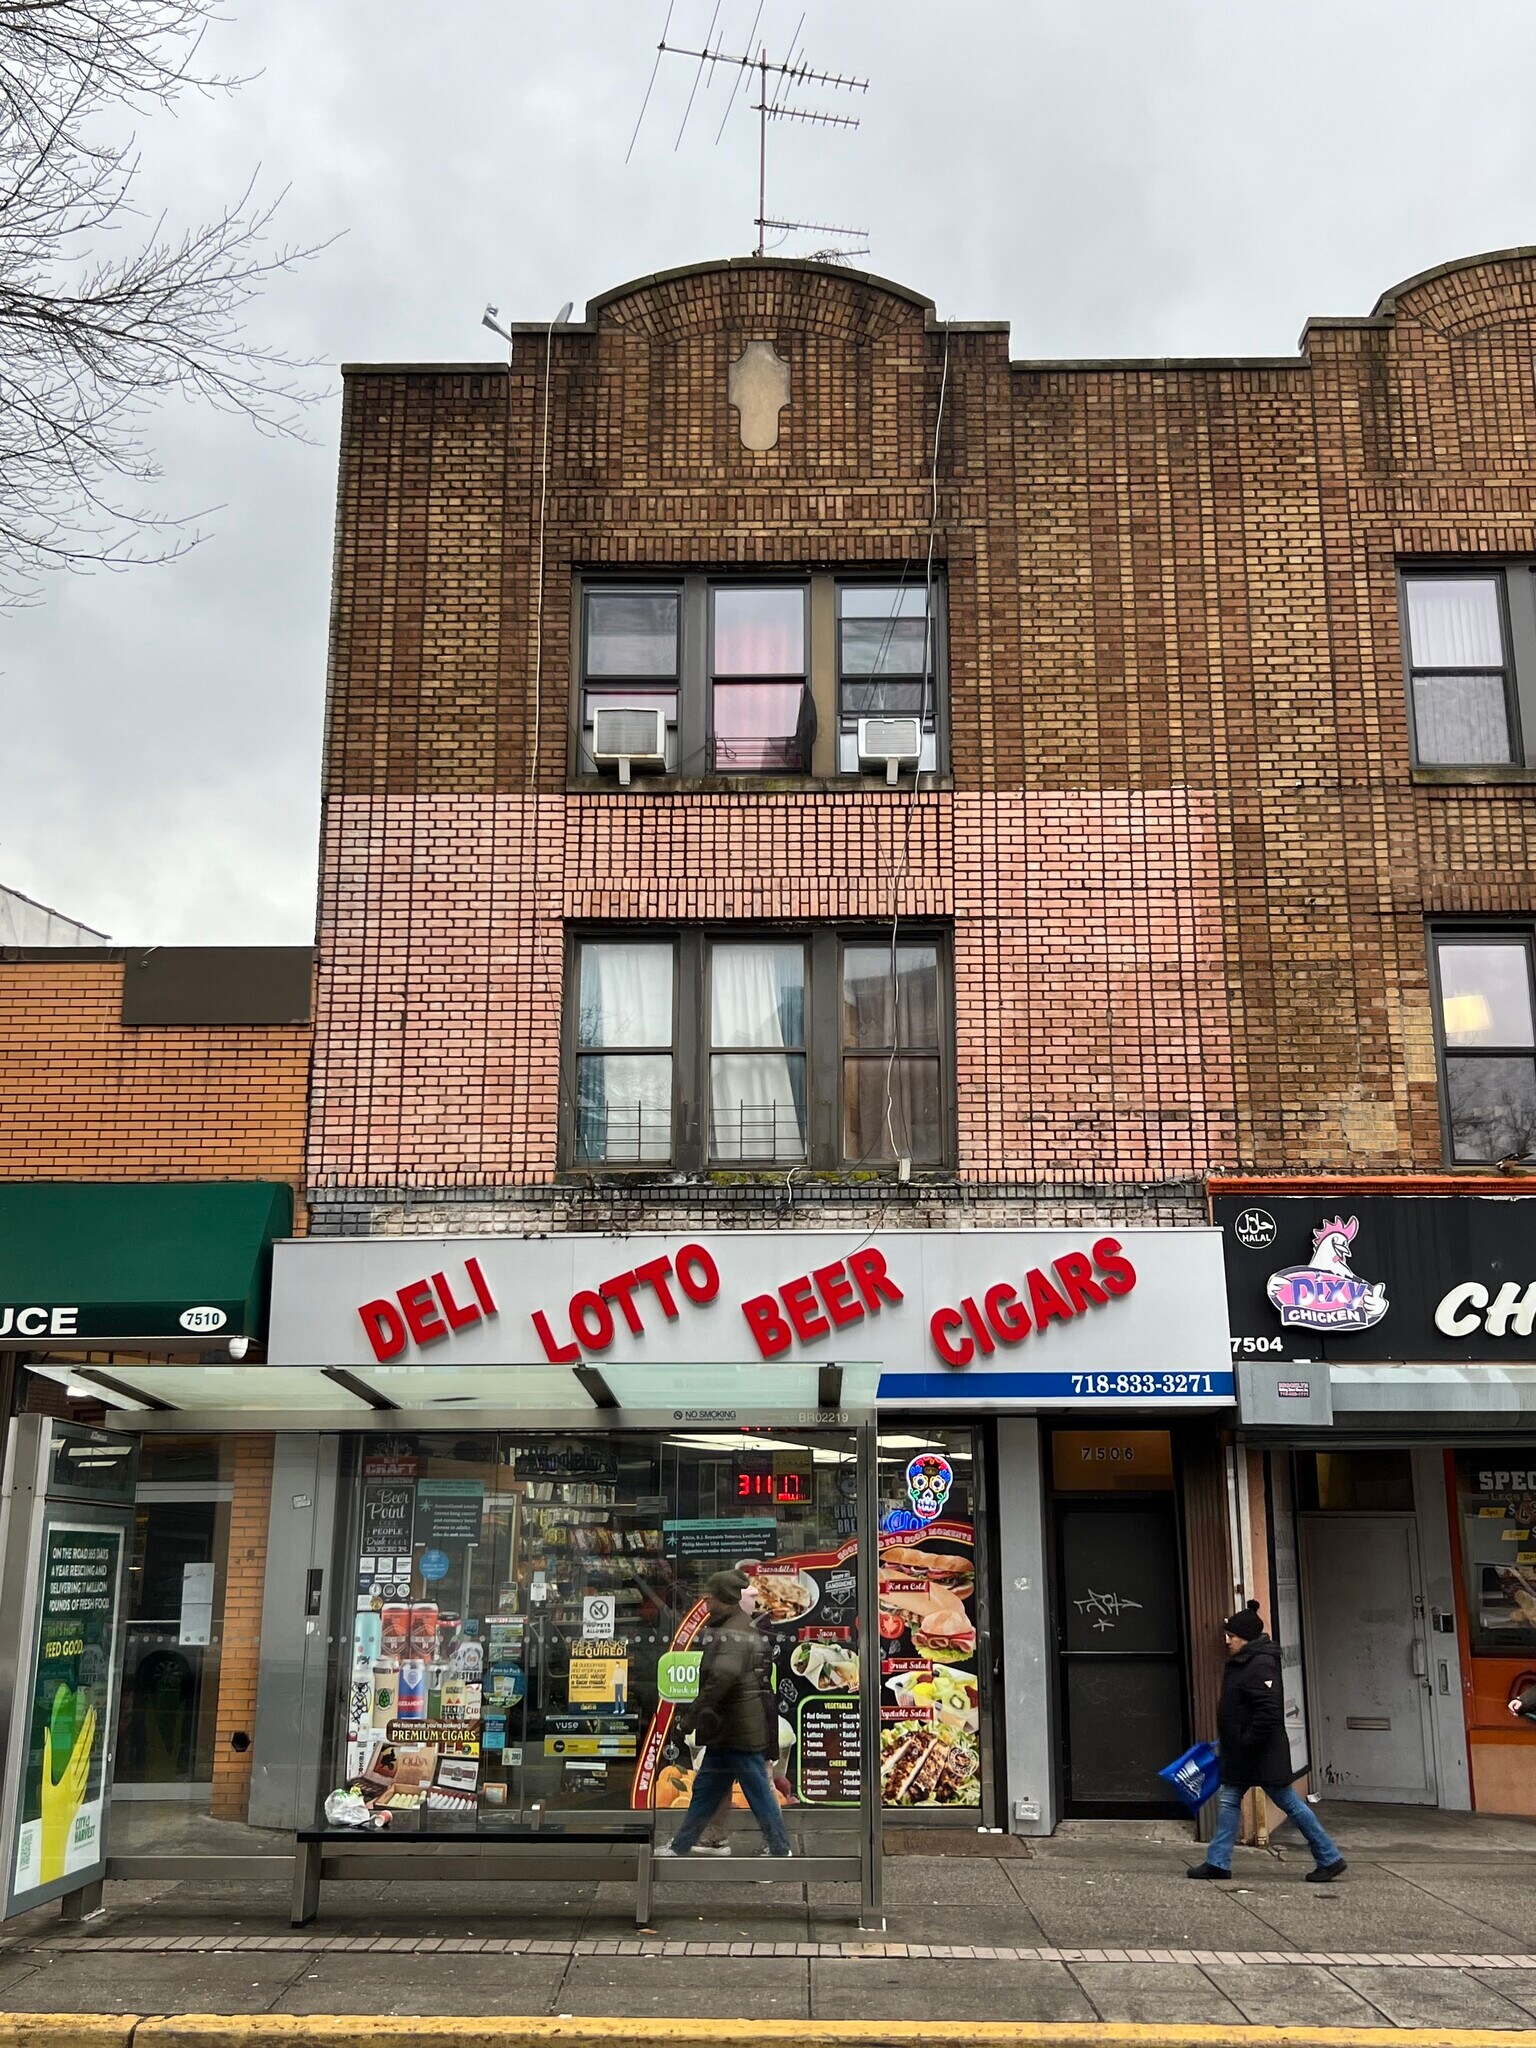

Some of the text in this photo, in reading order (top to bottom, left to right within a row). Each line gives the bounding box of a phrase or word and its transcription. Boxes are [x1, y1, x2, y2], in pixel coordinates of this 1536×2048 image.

[1242, 1234, 1271, 1242] HALAL
[531, 1244, 720, 1363] LOTTO
[741, 1247, 904, 1359] BEER
[930, 1237, 1137, 1366] CIGARS
[358, 1257, 497, 1362] DELI
[1434, 1281, 1536, 1337] CH
[186, 1313, 220, 1326] 7510
[1288, 1308, 1360, 1324] CHICKEN
[1231, 1337, 1284, 1353] 7504
[1071, 1374, 1214, 1394] 718-833-3271
[698, 1410, 736, 1419] SMOKING
[798, 1412, 849, 1423] BR02219
[1082, 1447, 1134, 1460] 7506
[366, 1463, 416, 1474] CRAFT
[738, 1474, 773, 1495] 311
[377, 1489, 409, 1504] Beer
[1490, 1492, 1520, 1501] LEGS
[366, 1502, 406, 1520] Point
[885, 1528, 972, 1546] FOR GOOD MOMENTS
[52, 1547, 61, 1559] ON
[62, 1547, 72, 1559] THE
[73, 1548, 88, 1559] ROAD
[96, 1549, 109, 1560] DAYS
[51, 1565, 107, 1576] A YEAR RESCUING AND
[756, 1565, 797, 1574] Quesadillas
[50, 1581, 107, 1594] DELIVERING MILLION
[888, 1581, 926, 1591] Hot or Cold
[49, 1599, 70, 1611] POUNDS
[71, 1599, 79, 1611] OF
[79, 1598, 94, 1611] FRESH
[45, 1639, 84, 1659] FEED GOOD.
[572, 1640, 626, 1649] FACE MASKS
[572, 1647, 627, 1657] REQUIRED!
[909, 1661, 931, 1670] Salad
[909, 1709, 931, 1718] Salad
[427, 1722, 443, 1730] you're
[443, 1722, 461, 1730] looking
[820, 1722, 838, 1731] Peppers
[392, 1730, 476, 1741] PREMIUM CIGARS
[639, 1773, 651, 1791] WE
[76, 1817, 86, 1830] CITY
[75, 1825, 95, 1843] HARVEST
